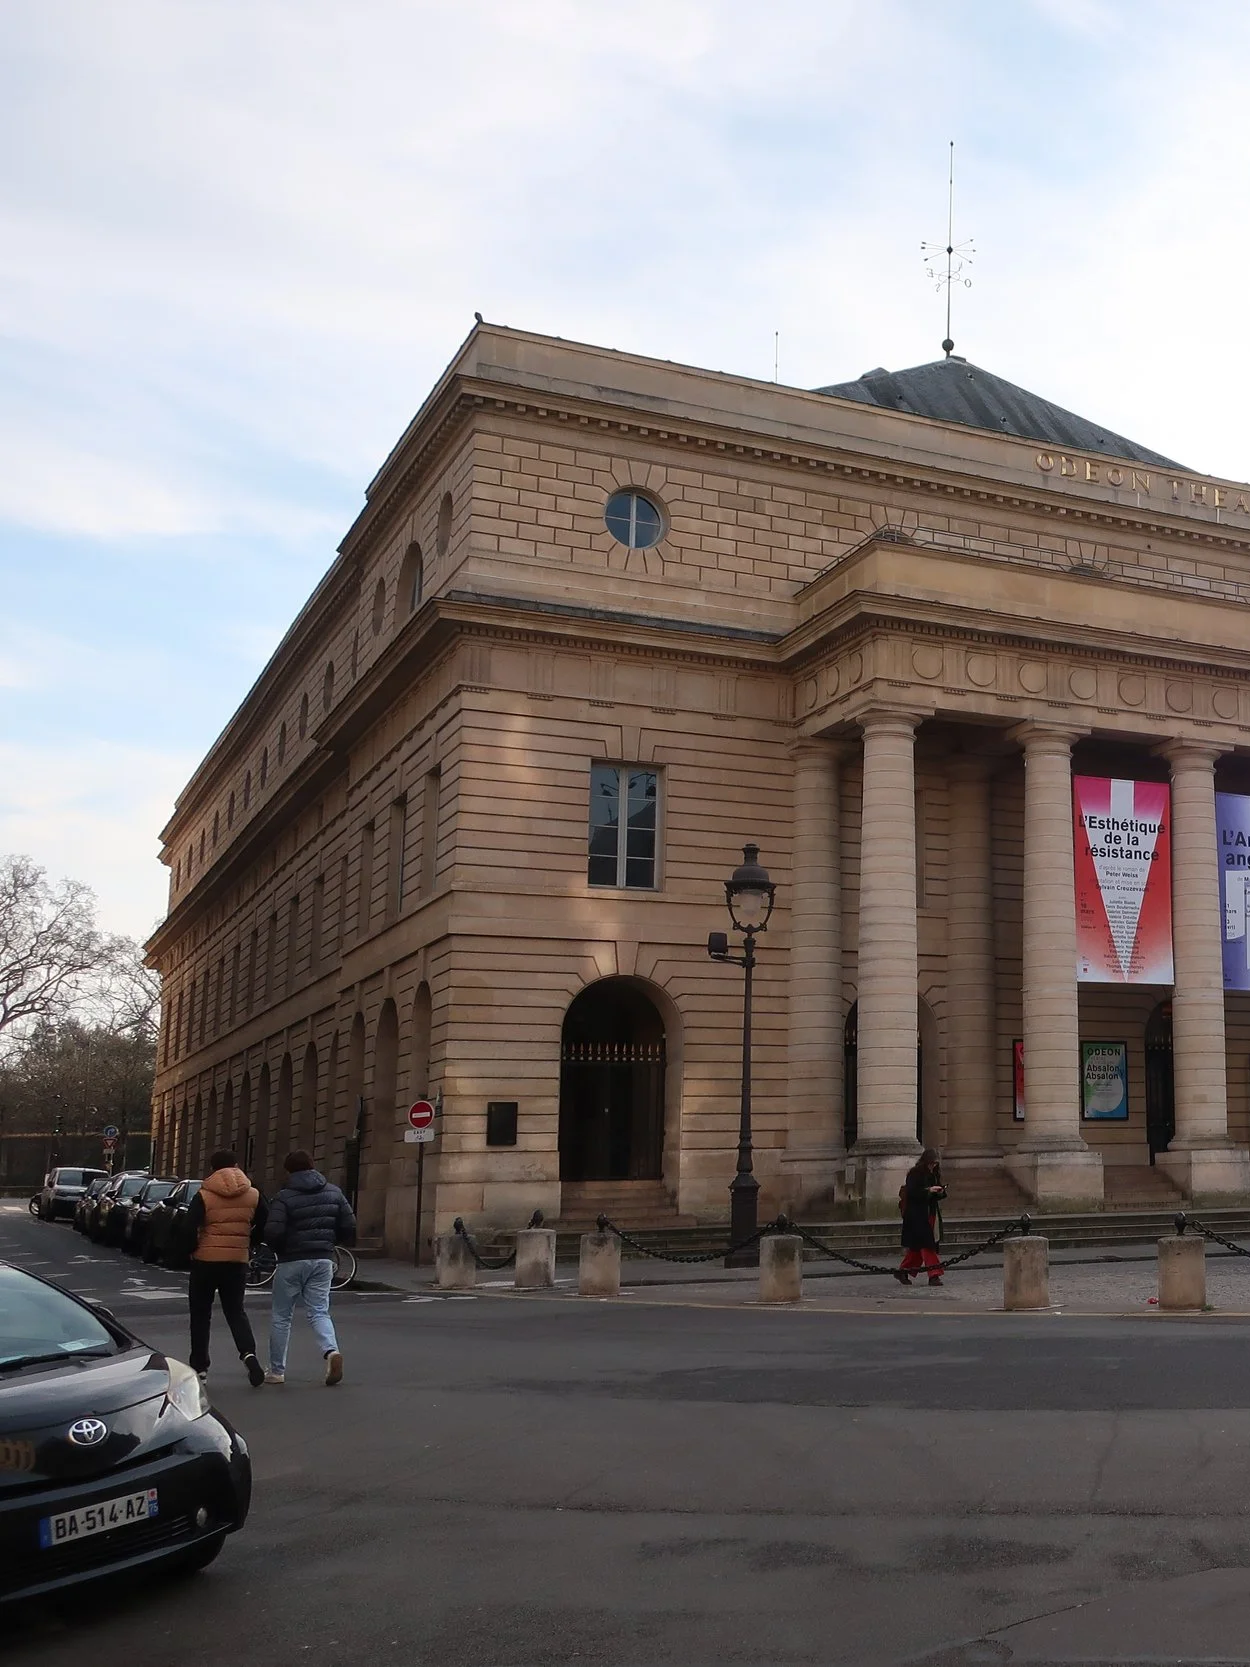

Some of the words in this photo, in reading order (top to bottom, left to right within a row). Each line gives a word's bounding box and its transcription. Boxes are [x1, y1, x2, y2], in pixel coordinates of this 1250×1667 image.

[1036, 453, 1150, 495] ODEON
[1079, 815, 1165, 836] L'Esthétique
[1104, 832, 1122, 844] de
[1127, 833, 1139, 846] la
[1085, 844, 1159, 860] résistance
[55, 1496, 146, 1539] BA-514-AZ
